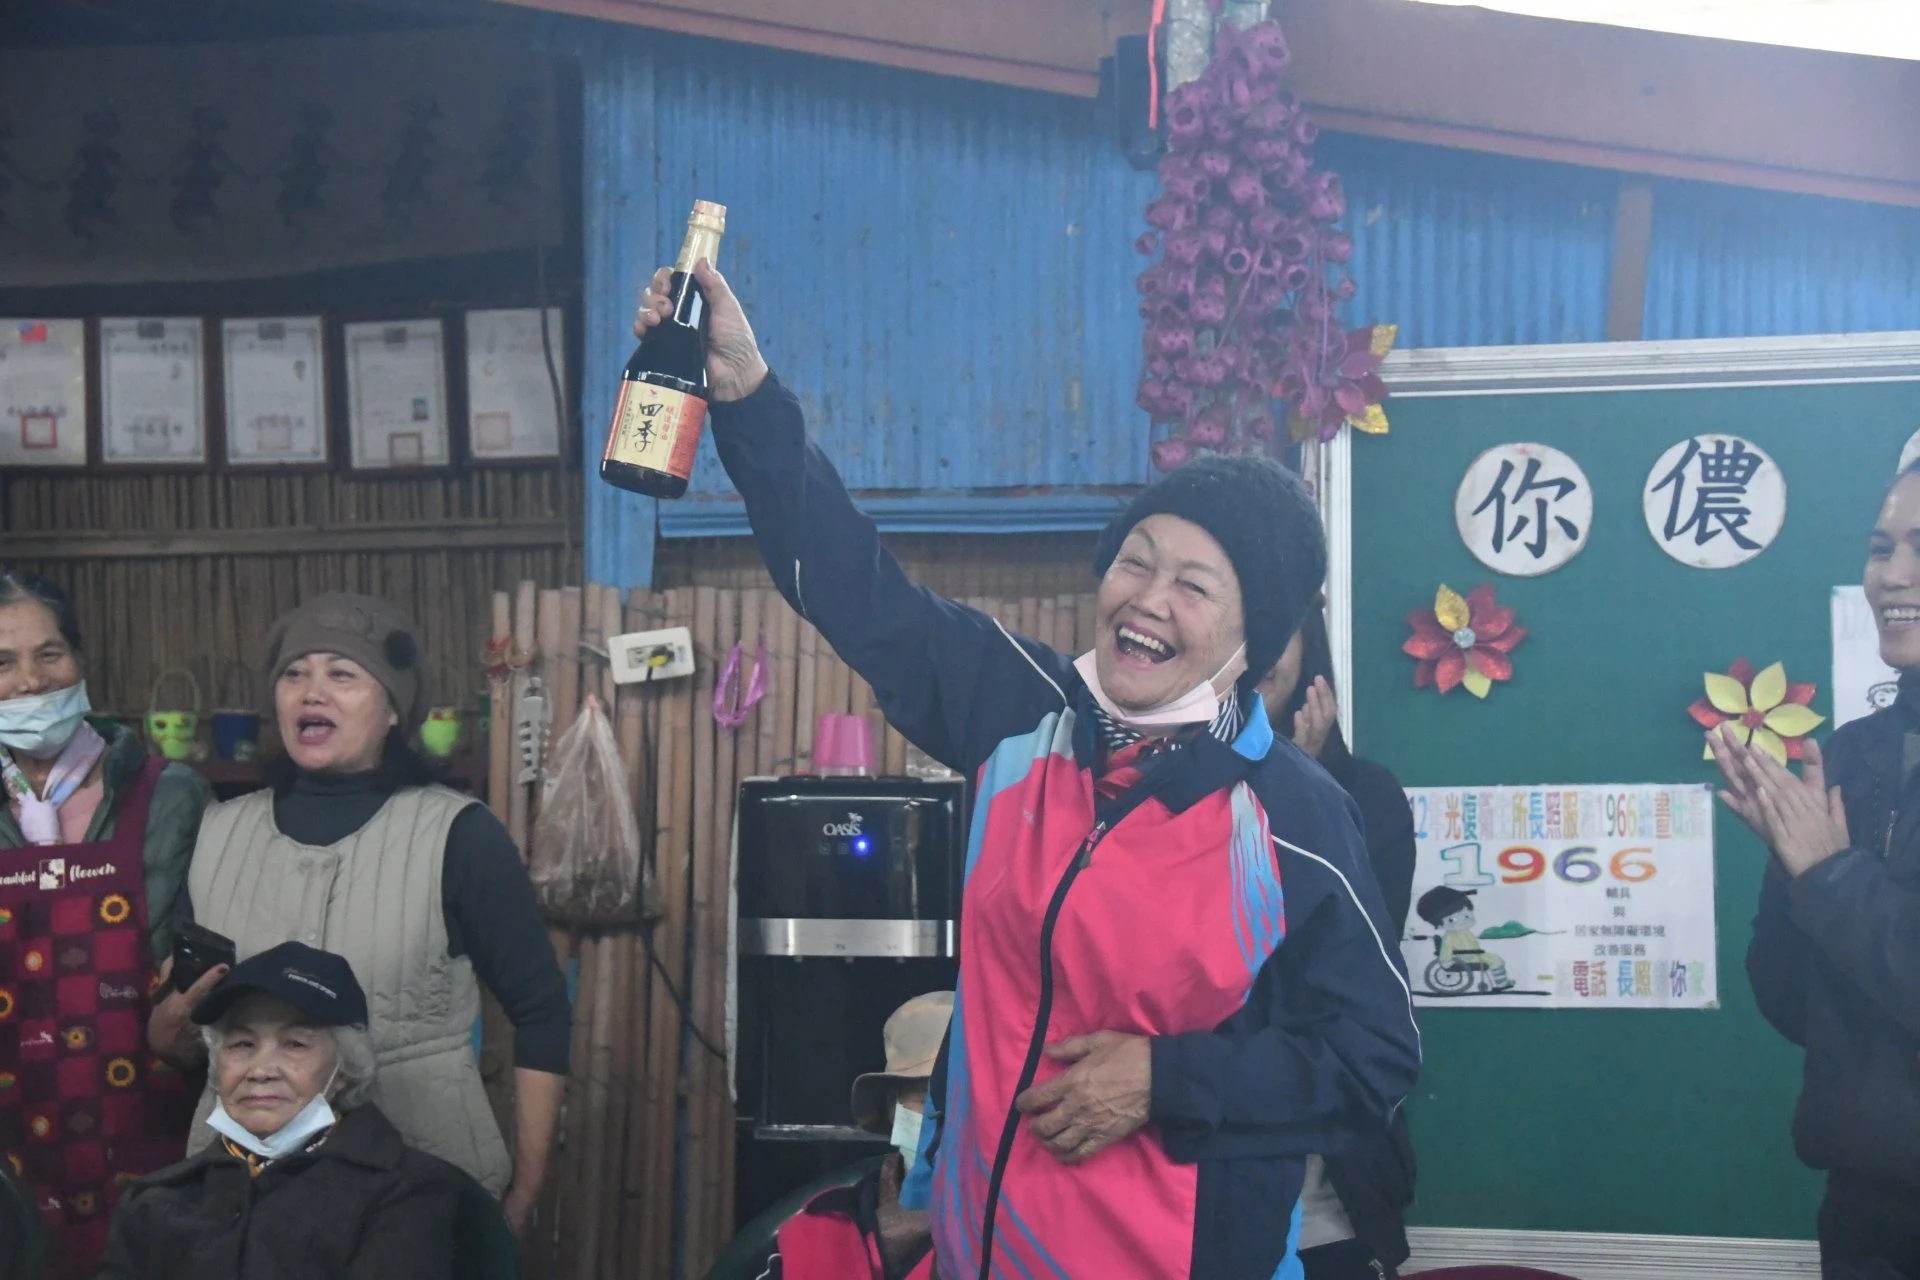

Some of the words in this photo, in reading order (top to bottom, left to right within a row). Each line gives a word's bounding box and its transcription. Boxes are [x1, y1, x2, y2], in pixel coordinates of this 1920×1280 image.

[633, 402, 664, 452] 四季
[1472, 458, 1580, 559] 你
[1651, 437, 1764, 551] 儂
[822, 816, 863, 836] OASIS
[69, 862, 117, 883] flower
[1440, 842, 1658, 887] 1966
[1593, 943, 1646, 957] 改善服務
